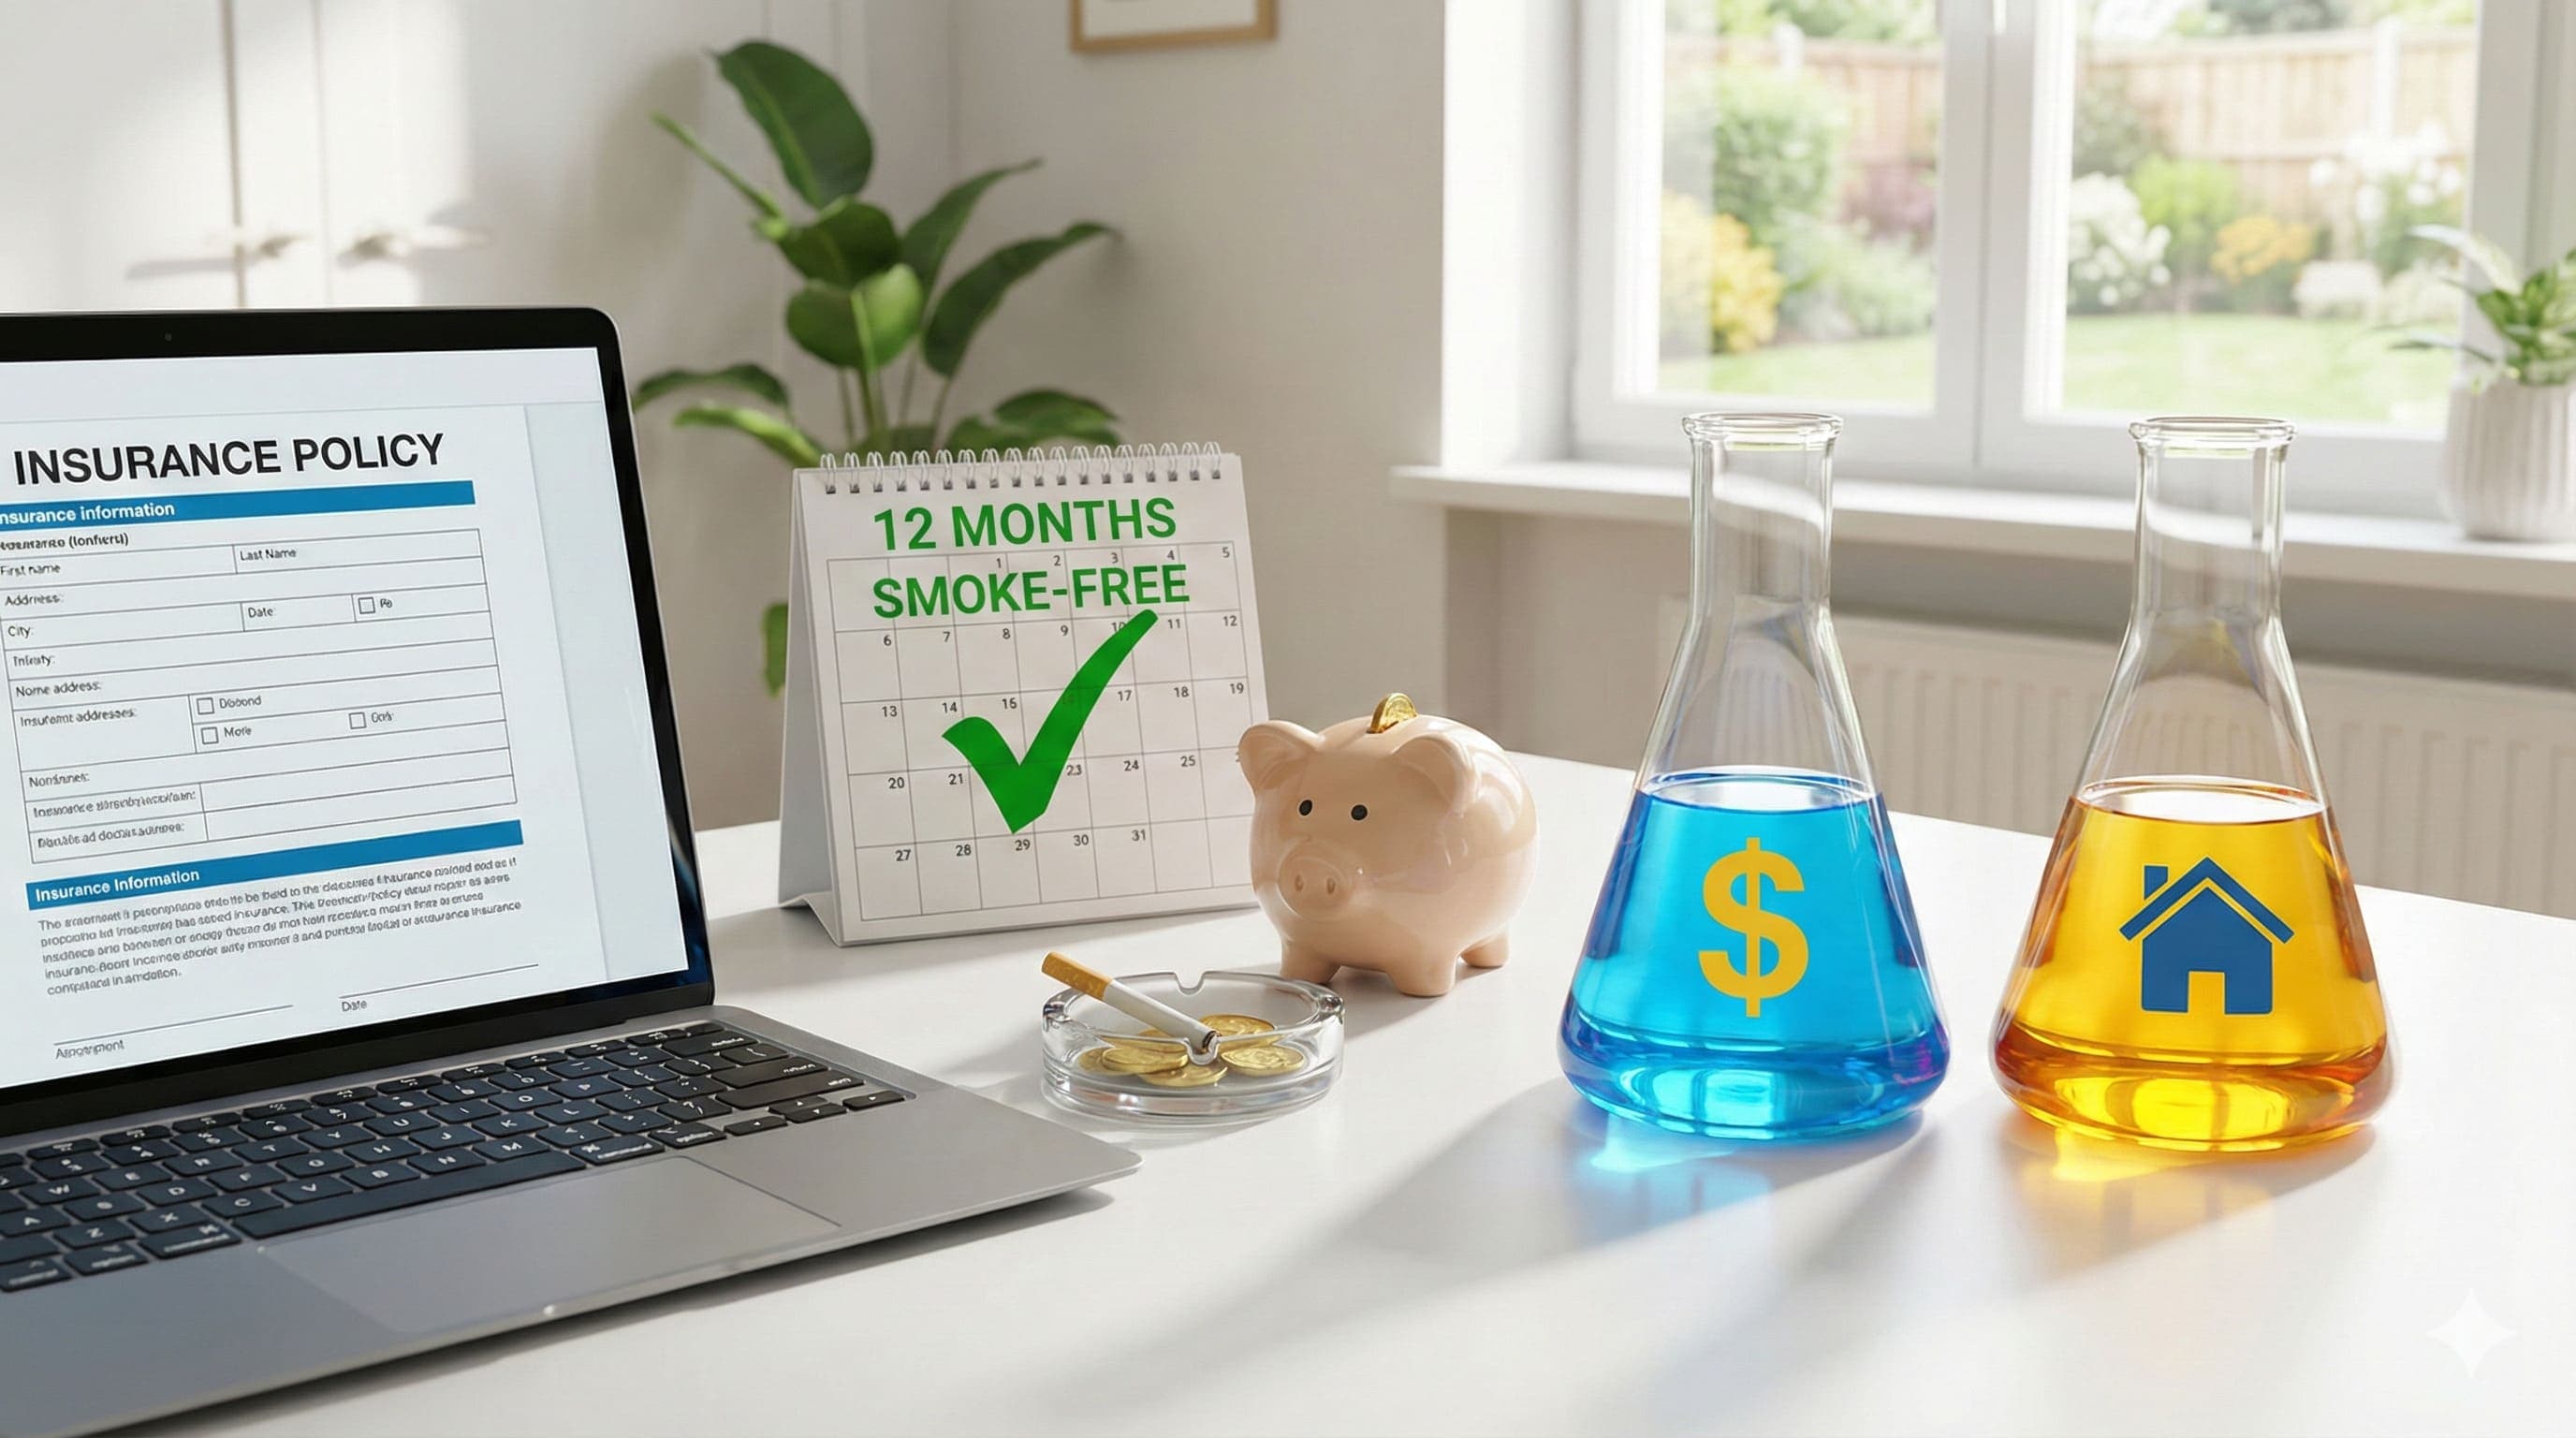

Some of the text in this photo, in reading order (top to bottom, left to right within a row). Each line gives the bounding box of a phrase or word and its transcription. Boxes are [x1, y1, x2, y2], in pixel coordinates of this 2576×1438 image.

[13, 433, 444, 486] INSURANCE POLICY
[0, 502, 175, 525] nsurance information
[874, 497, 1176, 550] 12 MONTHS
[240, 549, 297, 562] Last Name
[996, 546, 1230, 568] 1 2 3 4 5
[873, 564, 1190, 618] SMOKE-FREE
[883, 635, 892, 646] 6
[943, 631, 951, 642] 7
[1003, 628, 1011, 639] 8
[1060, 624, 1069, 636] 9
[1167, 618, 1180, 629] 11
[1222, 614, 1237, 626] 12
[882, 705, 898, 718] 13
[942, 701, 958, 713] 14
[1118, 689, 1132, 701] 17
[1174, 685, 1190, 698] 18
[1230, 682, 1244, 694] 19
[887, 776, 905, 789] 20
[948, 772, 963, 785] 21
[1123, 759, 1139, 771] 24
[1180, 755, 1196, 768] 25
[895, 829, 1146, 862] 27 28 29 30 31
[36, 871, 199, 902] Insurance Information
[1698, 837, 1810, 1018] $
